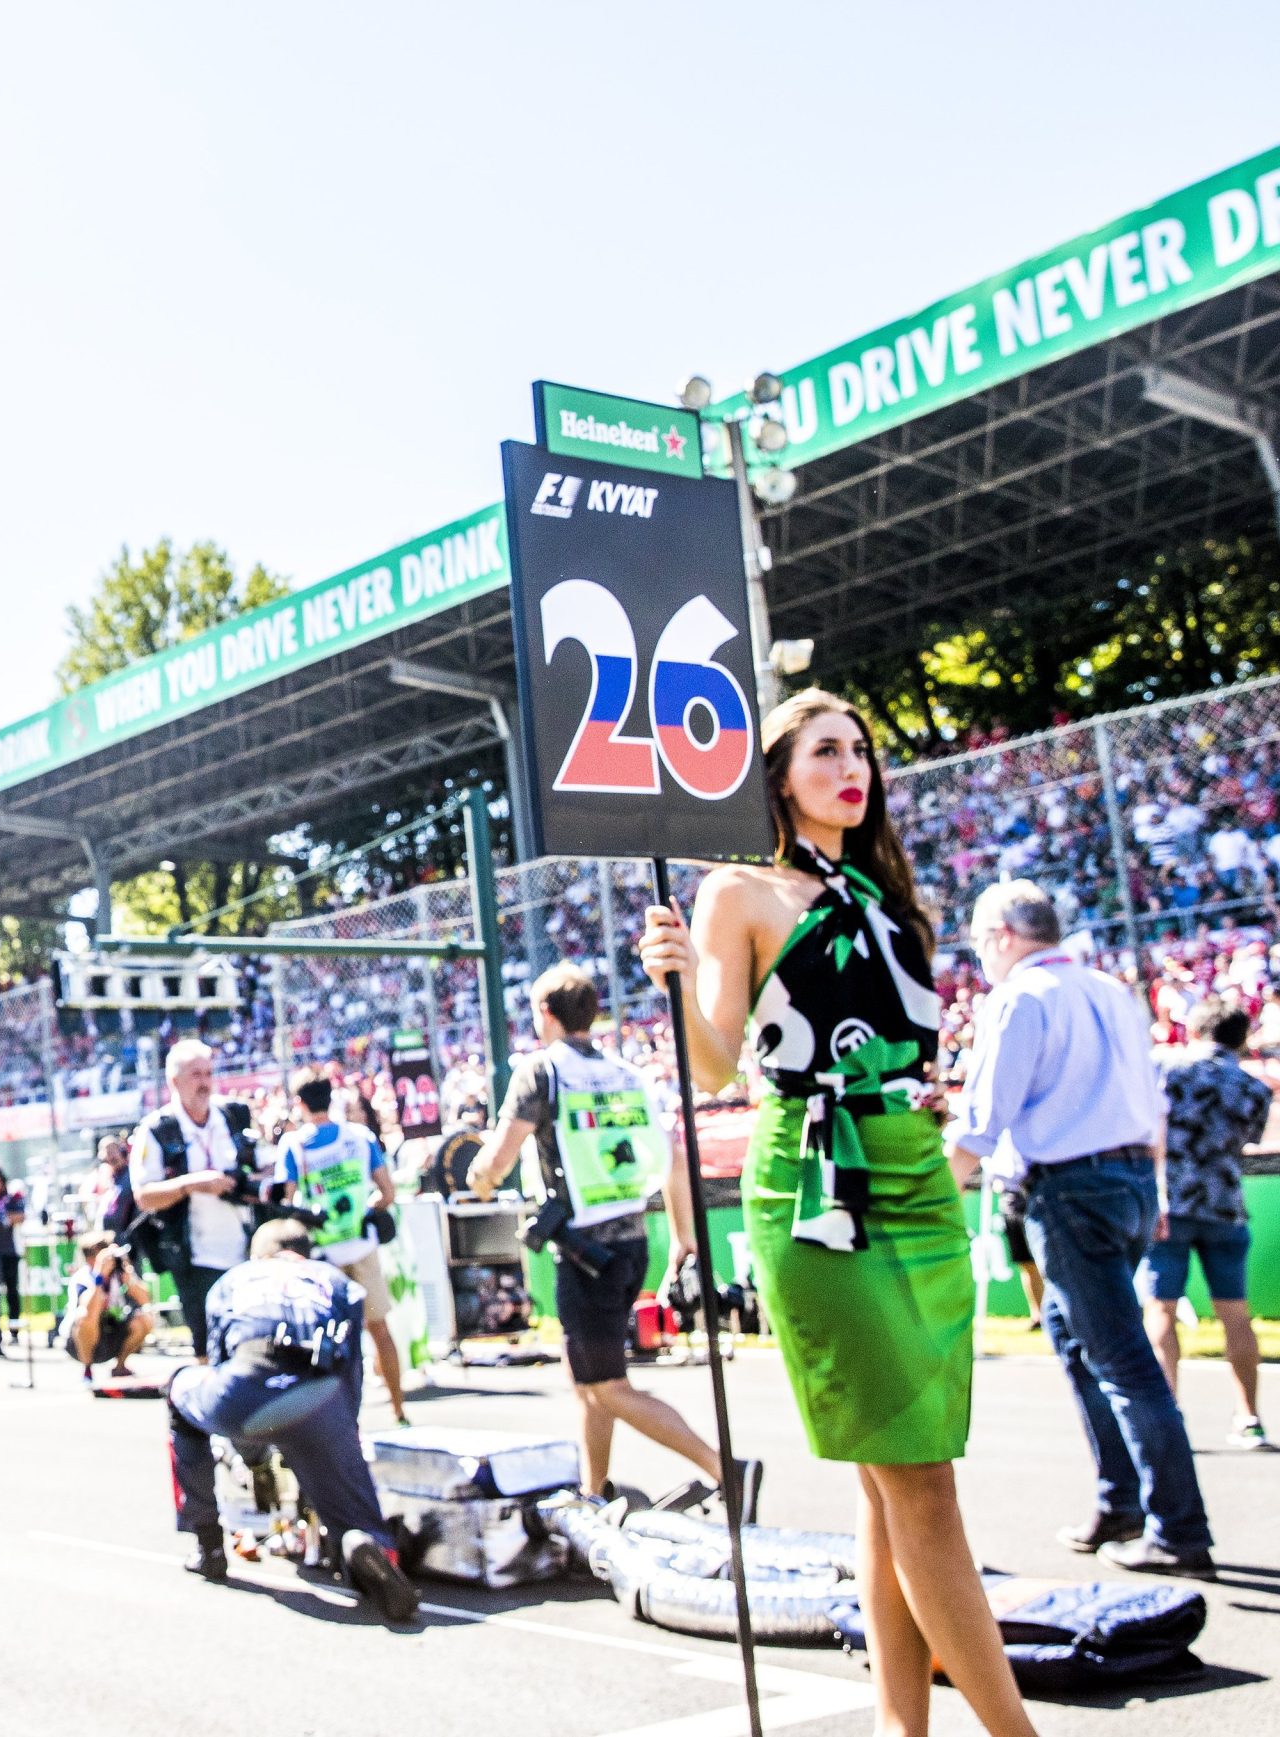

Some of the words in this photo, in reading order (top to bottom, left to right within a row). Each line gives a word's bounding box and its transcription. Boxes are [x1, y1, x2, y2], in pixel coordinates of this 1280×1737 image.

[828, 304, 982, 427] DRIVE
[992, 217, 1194, 357] NEVER
[560, 410, 659, 453] Heineken
[587, 480, 658, 518] KVYAT
[94, 667, 161, 733] WHEN
[164, 643, 217, 704] YOU
[221, 607, 298, 682] DRIVE
[302, 567, 395, 647] NEVER
[400, 517, 503, 607] DRINK
[540, 578, 754, 801] 26
